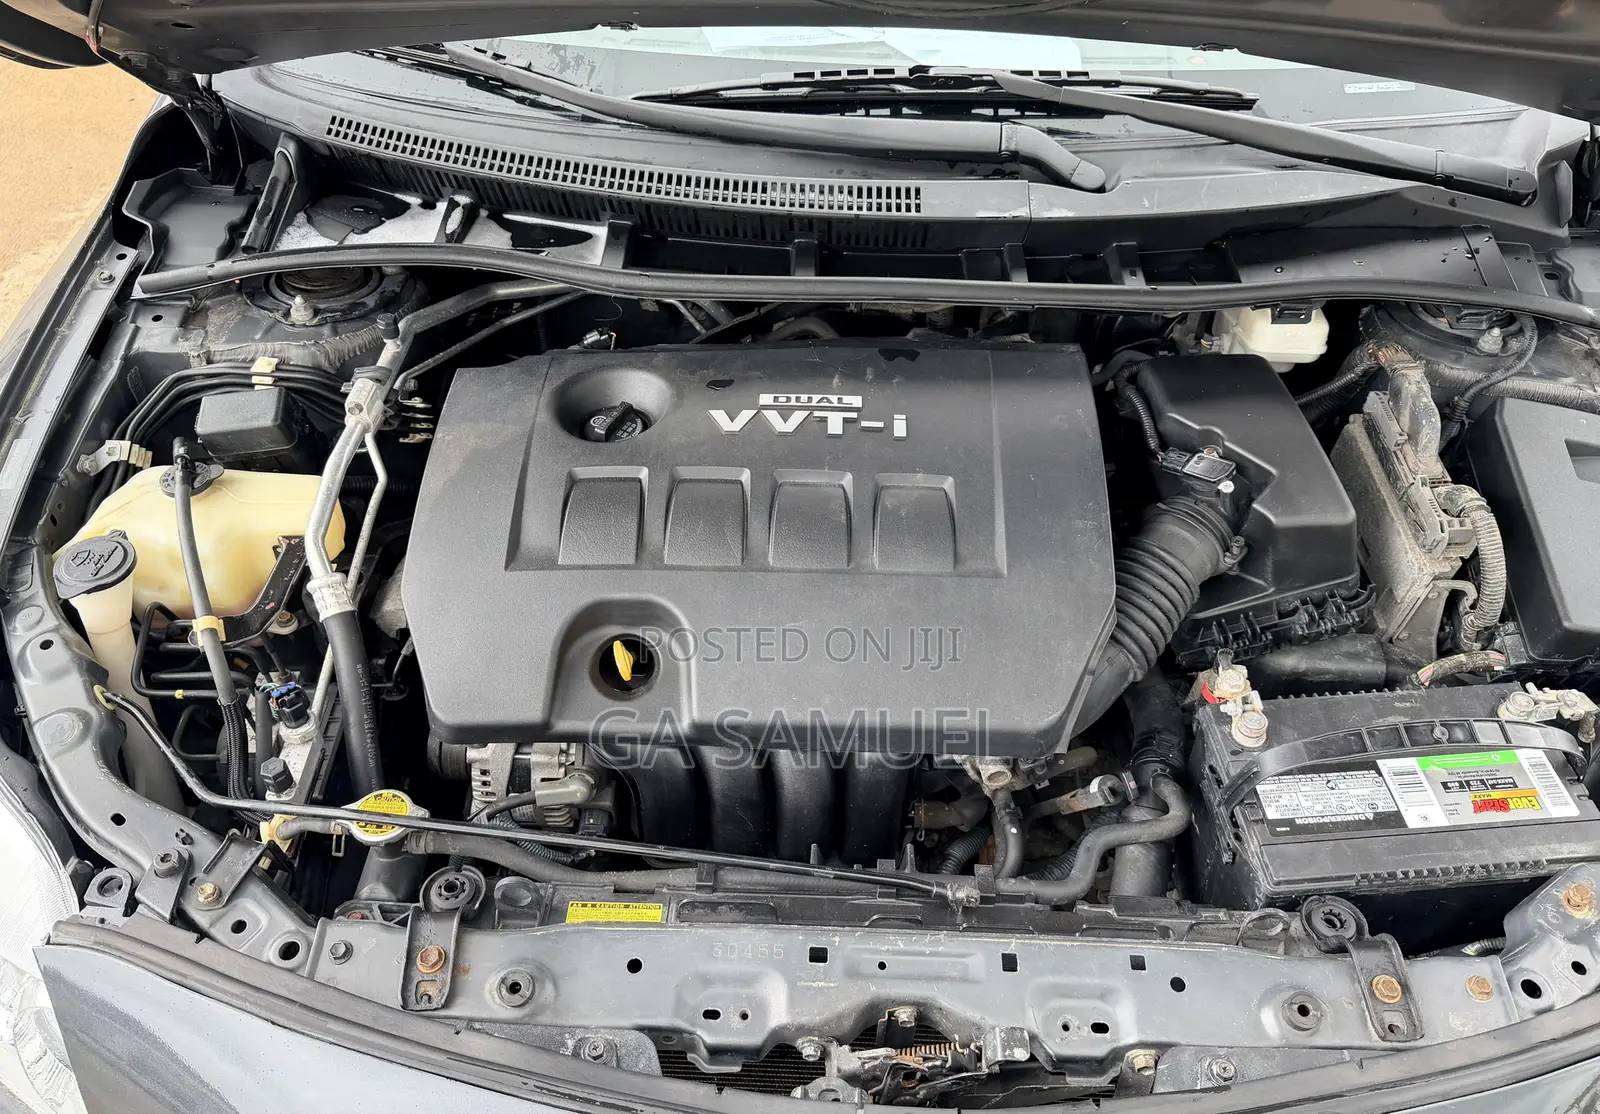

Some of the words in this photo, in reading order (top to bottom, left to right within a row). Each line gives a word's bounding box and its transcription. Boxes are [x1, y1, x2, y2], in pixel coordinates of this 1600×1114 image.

[772, 395, 854, 405] DUAL
[708, 409, 907, 440] VVT-i
[1471, 796, 1542, 814] EverStart
[712, 942, 784, 959] 30455
